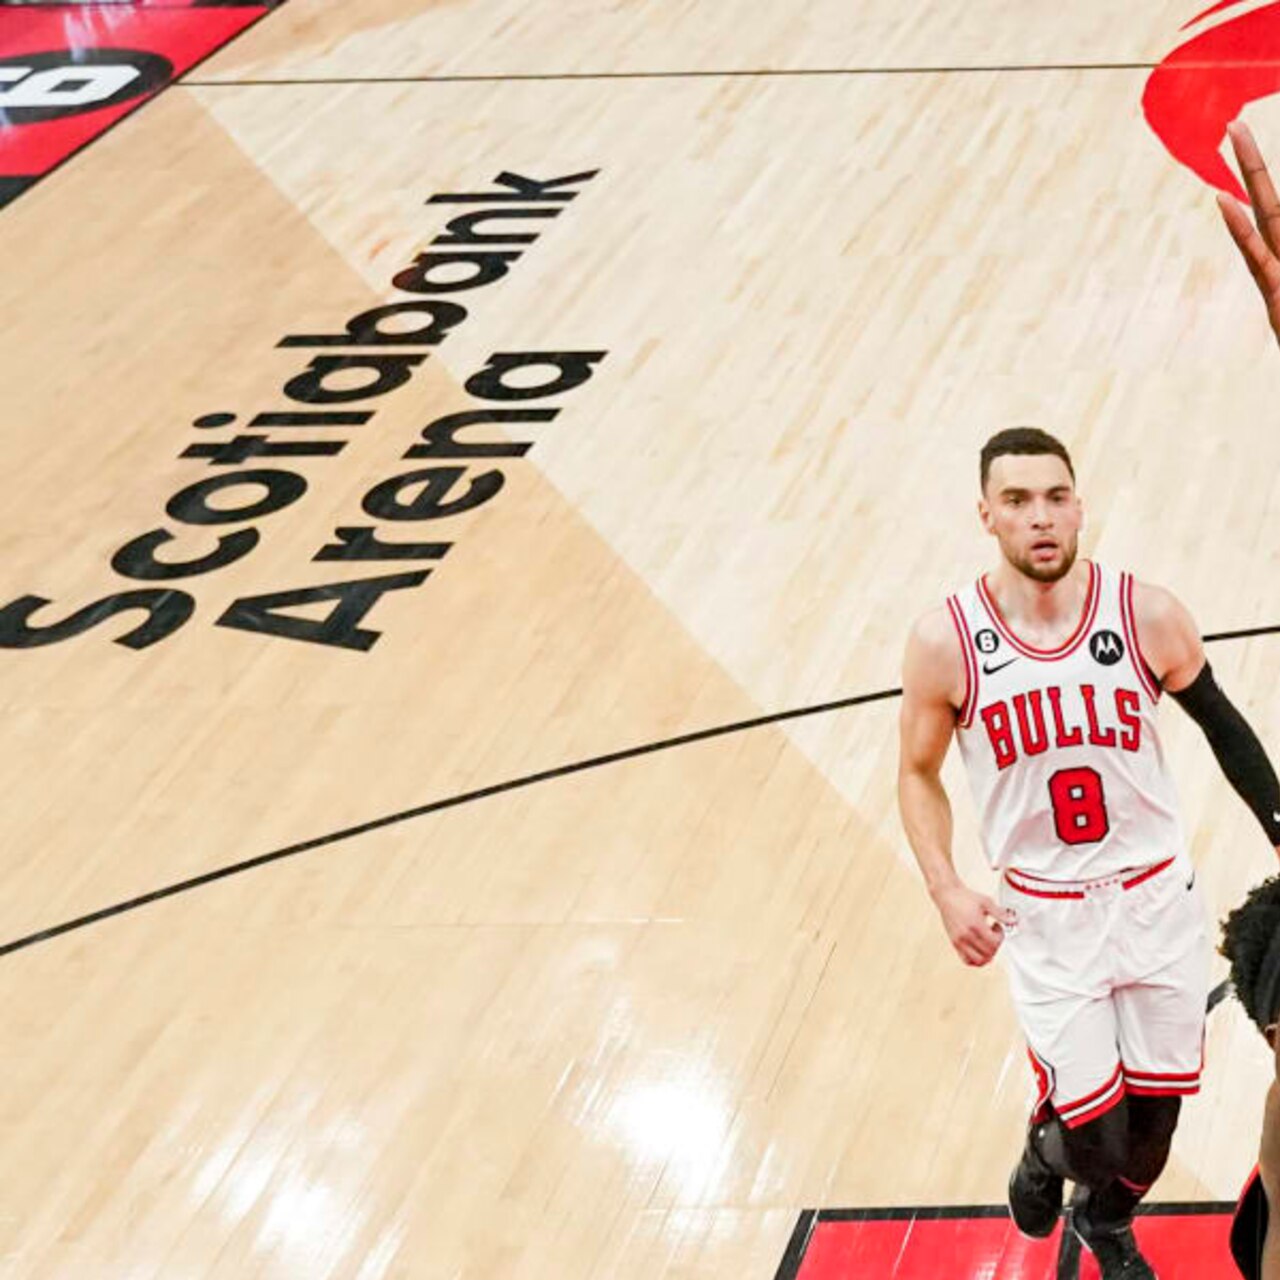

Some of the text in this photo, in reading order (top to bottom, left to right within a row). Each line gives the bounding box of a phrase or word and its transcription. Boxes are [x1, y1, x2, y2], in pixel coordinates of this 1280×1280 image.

[0, 168, 601, 650] Scotiabank
[213, 349, 609, 653] Arena
[980, 684, 1141, 771] BULLS
[1047, 766, 1110, 846] 8
